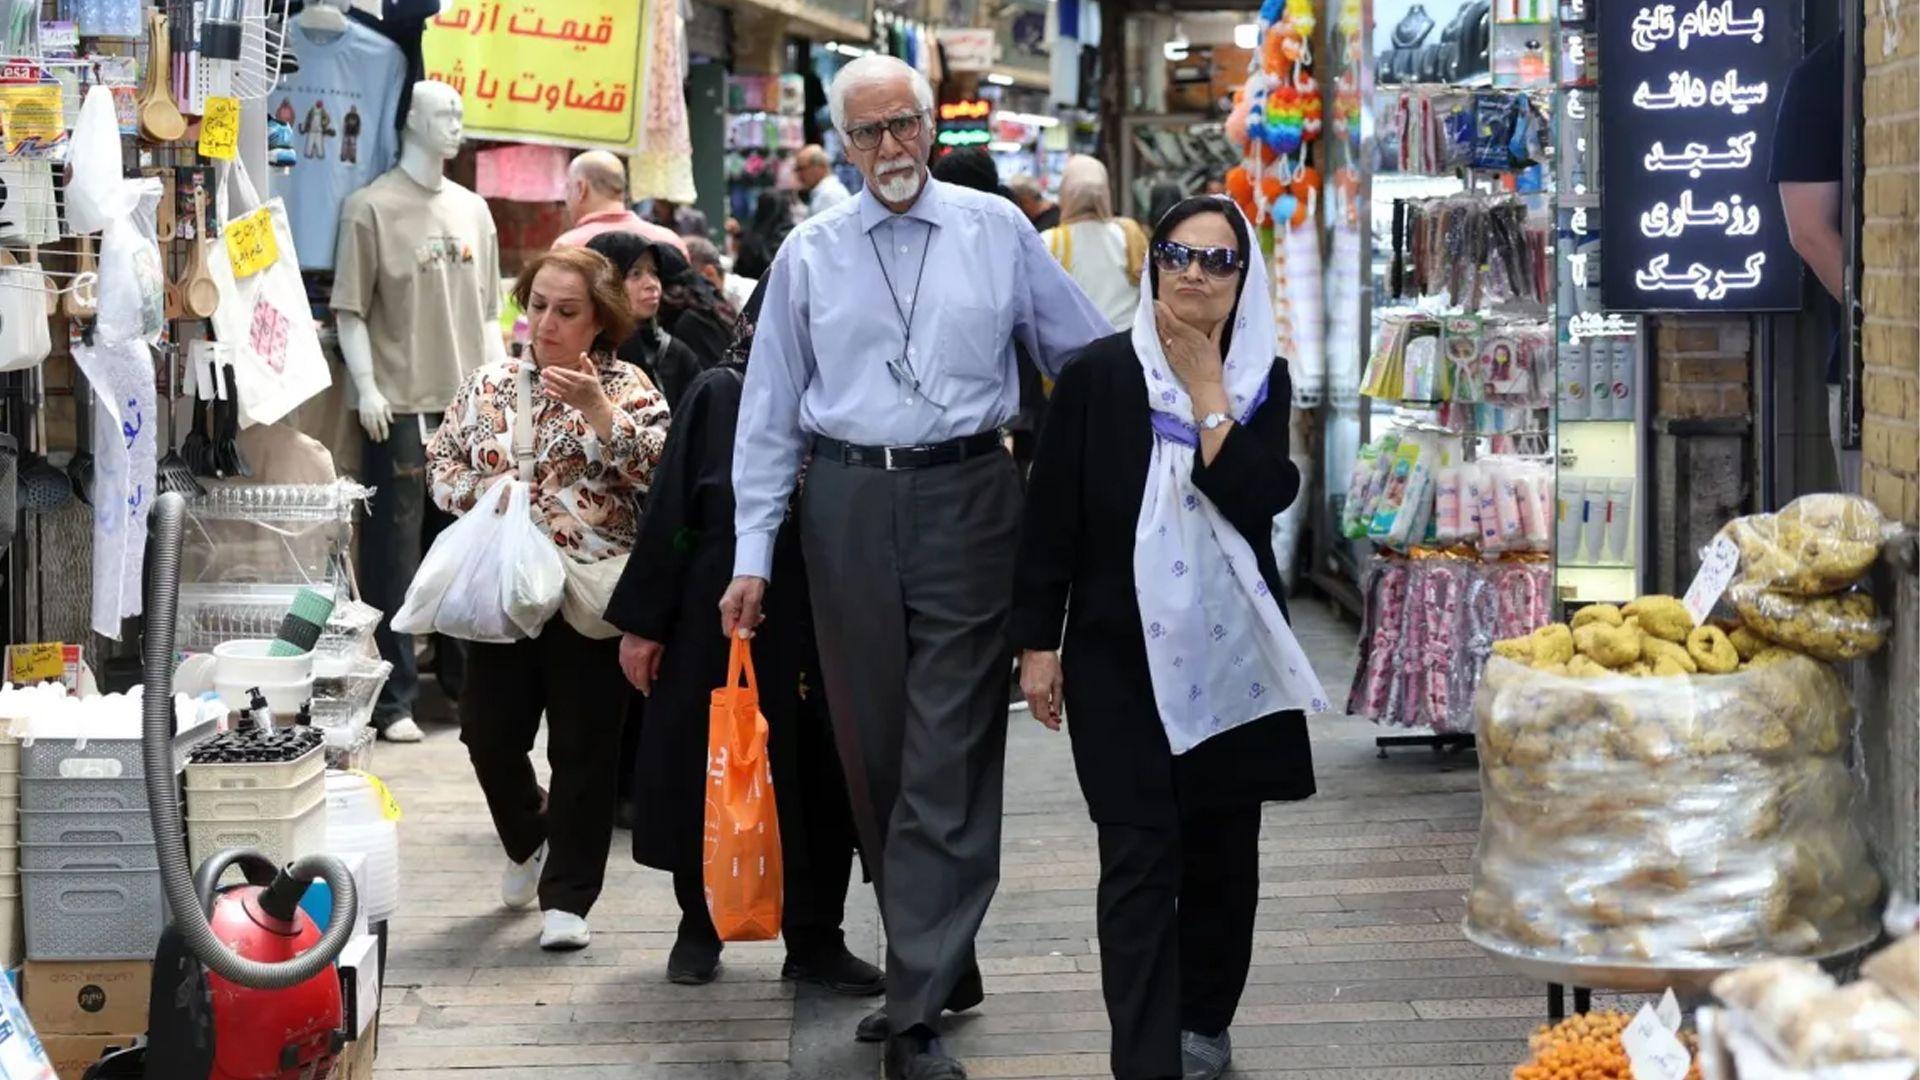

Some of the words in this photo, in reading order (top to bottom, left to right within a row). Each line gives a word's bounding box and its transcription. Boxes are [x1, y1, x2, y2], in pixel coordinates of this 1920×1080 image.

[471, 2, 501, 35] از
[507, 7, 613, 51] قیمت
[1631, 3, 1676, 52] تلخ
[1678, 0, 1765, 50] بادام
[475, 68, 499, 109] با
[507, 74, 627, 114] قضاوت
[1632, 70, 1708, 110] دانه
[1709, 68, 1769, 115] سیاه
[1643, 130, 1757, 179] کنجد
[1639, 189, 1761, 238] رزماری
[1635, 251, 1766, 301] کرچک
